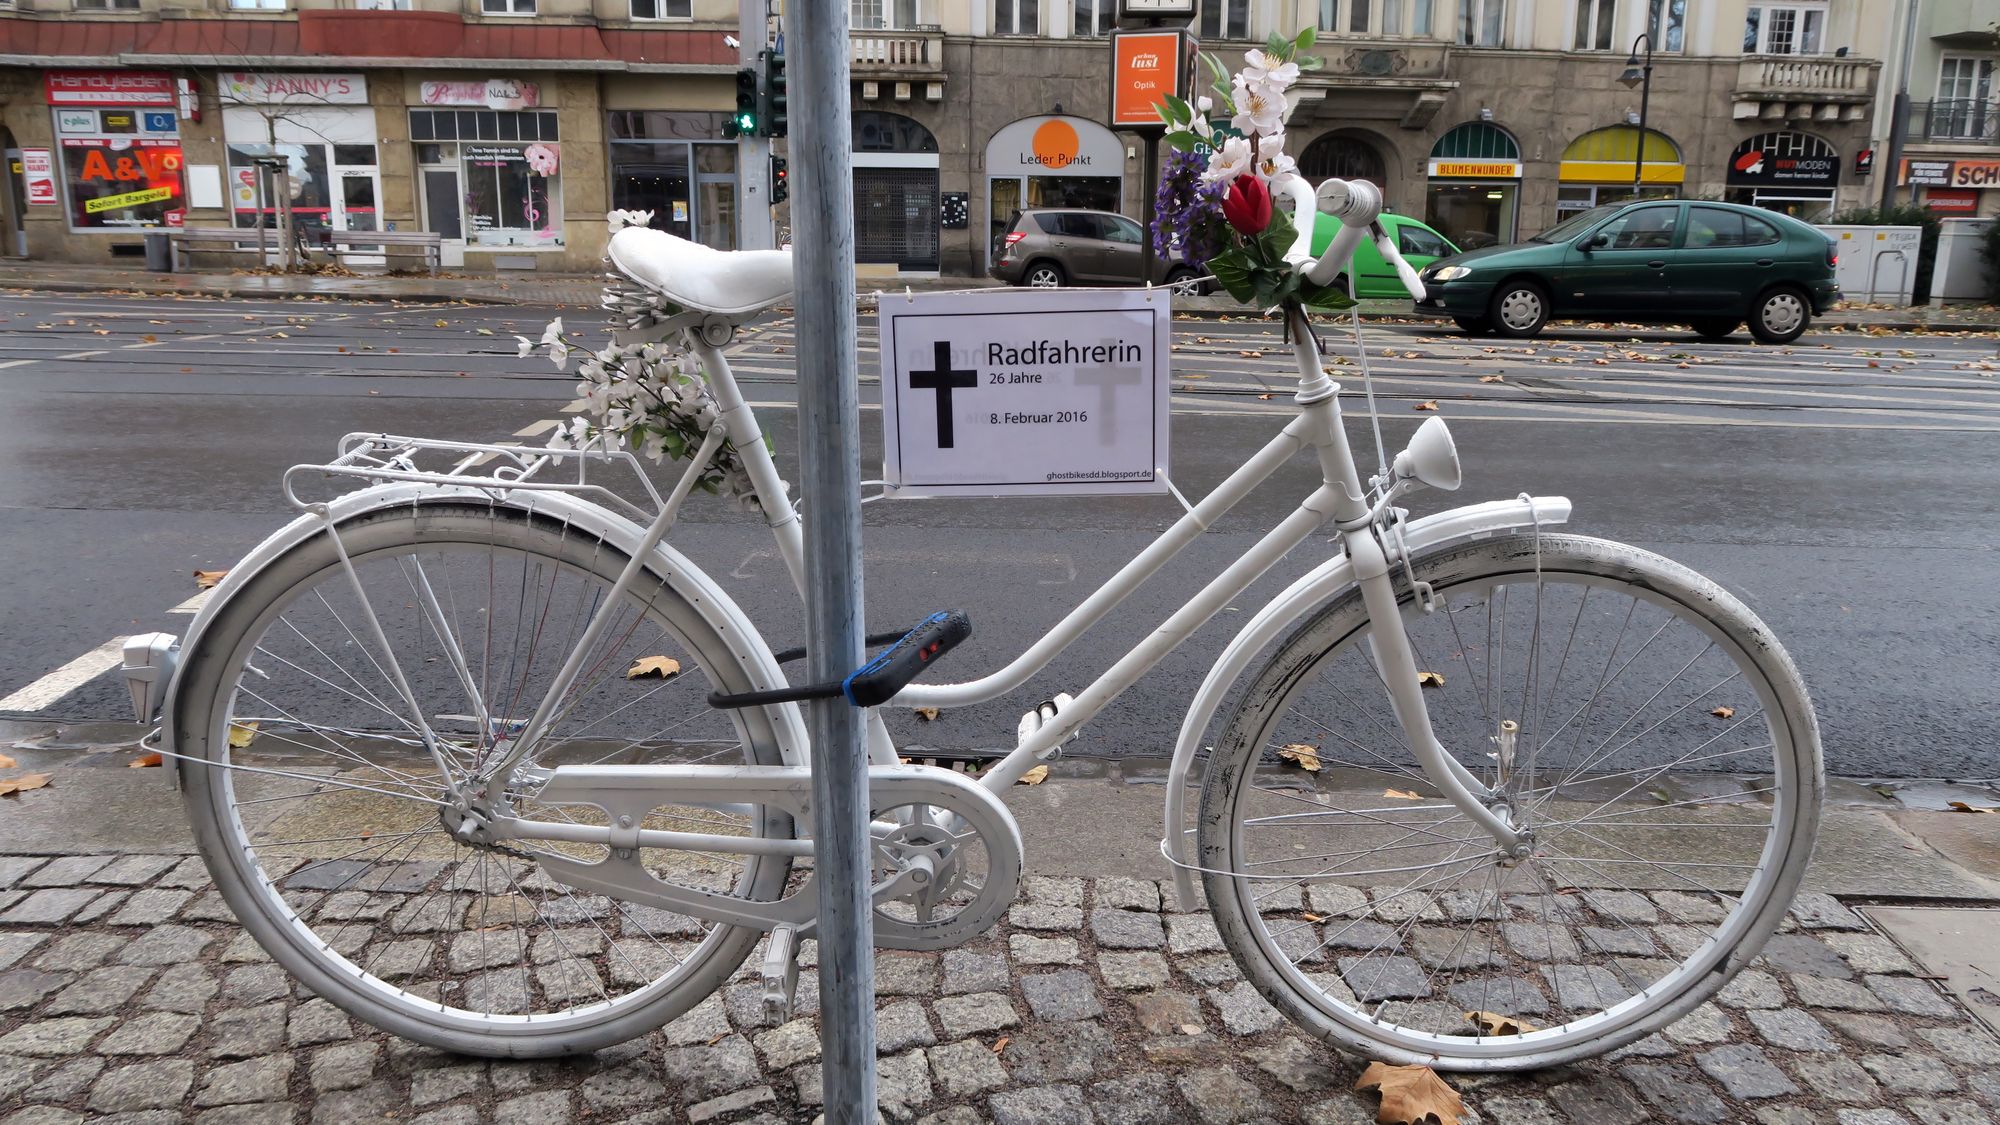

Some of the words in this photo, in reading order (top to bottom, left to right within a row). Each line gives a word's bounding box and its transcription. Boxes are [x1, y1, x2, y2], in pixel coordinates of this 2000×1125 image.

[1131, 55, 1158, 68] lust
[262, 78, 350, 95] JANNY'S
[1134, 80, 1156, 90] Optik
[1020, 152, 1053, 165] Leder
[1058, 153, 1092, 166] Punkt
[1440, 164, 1512, 175] BLUMENWUNDER
[1957, 166, 2000, 185] SCH
[88, 199, 122, 210] Sofort
[125, 191, 167, 203] Bargeld
[988, 339, 1142, 366] Radfahrerin
[989, 373, 1005, 385] 26
[1008, 371, 1042, 384] Jahre
[990, 413, 1001, 424] 8.
[1004, 412, 1053, 424] Februar
[1056, 411, 1088, 423] 2016
[1046, 470, 1152, 481] ghostbikesdd.blogsport.de
